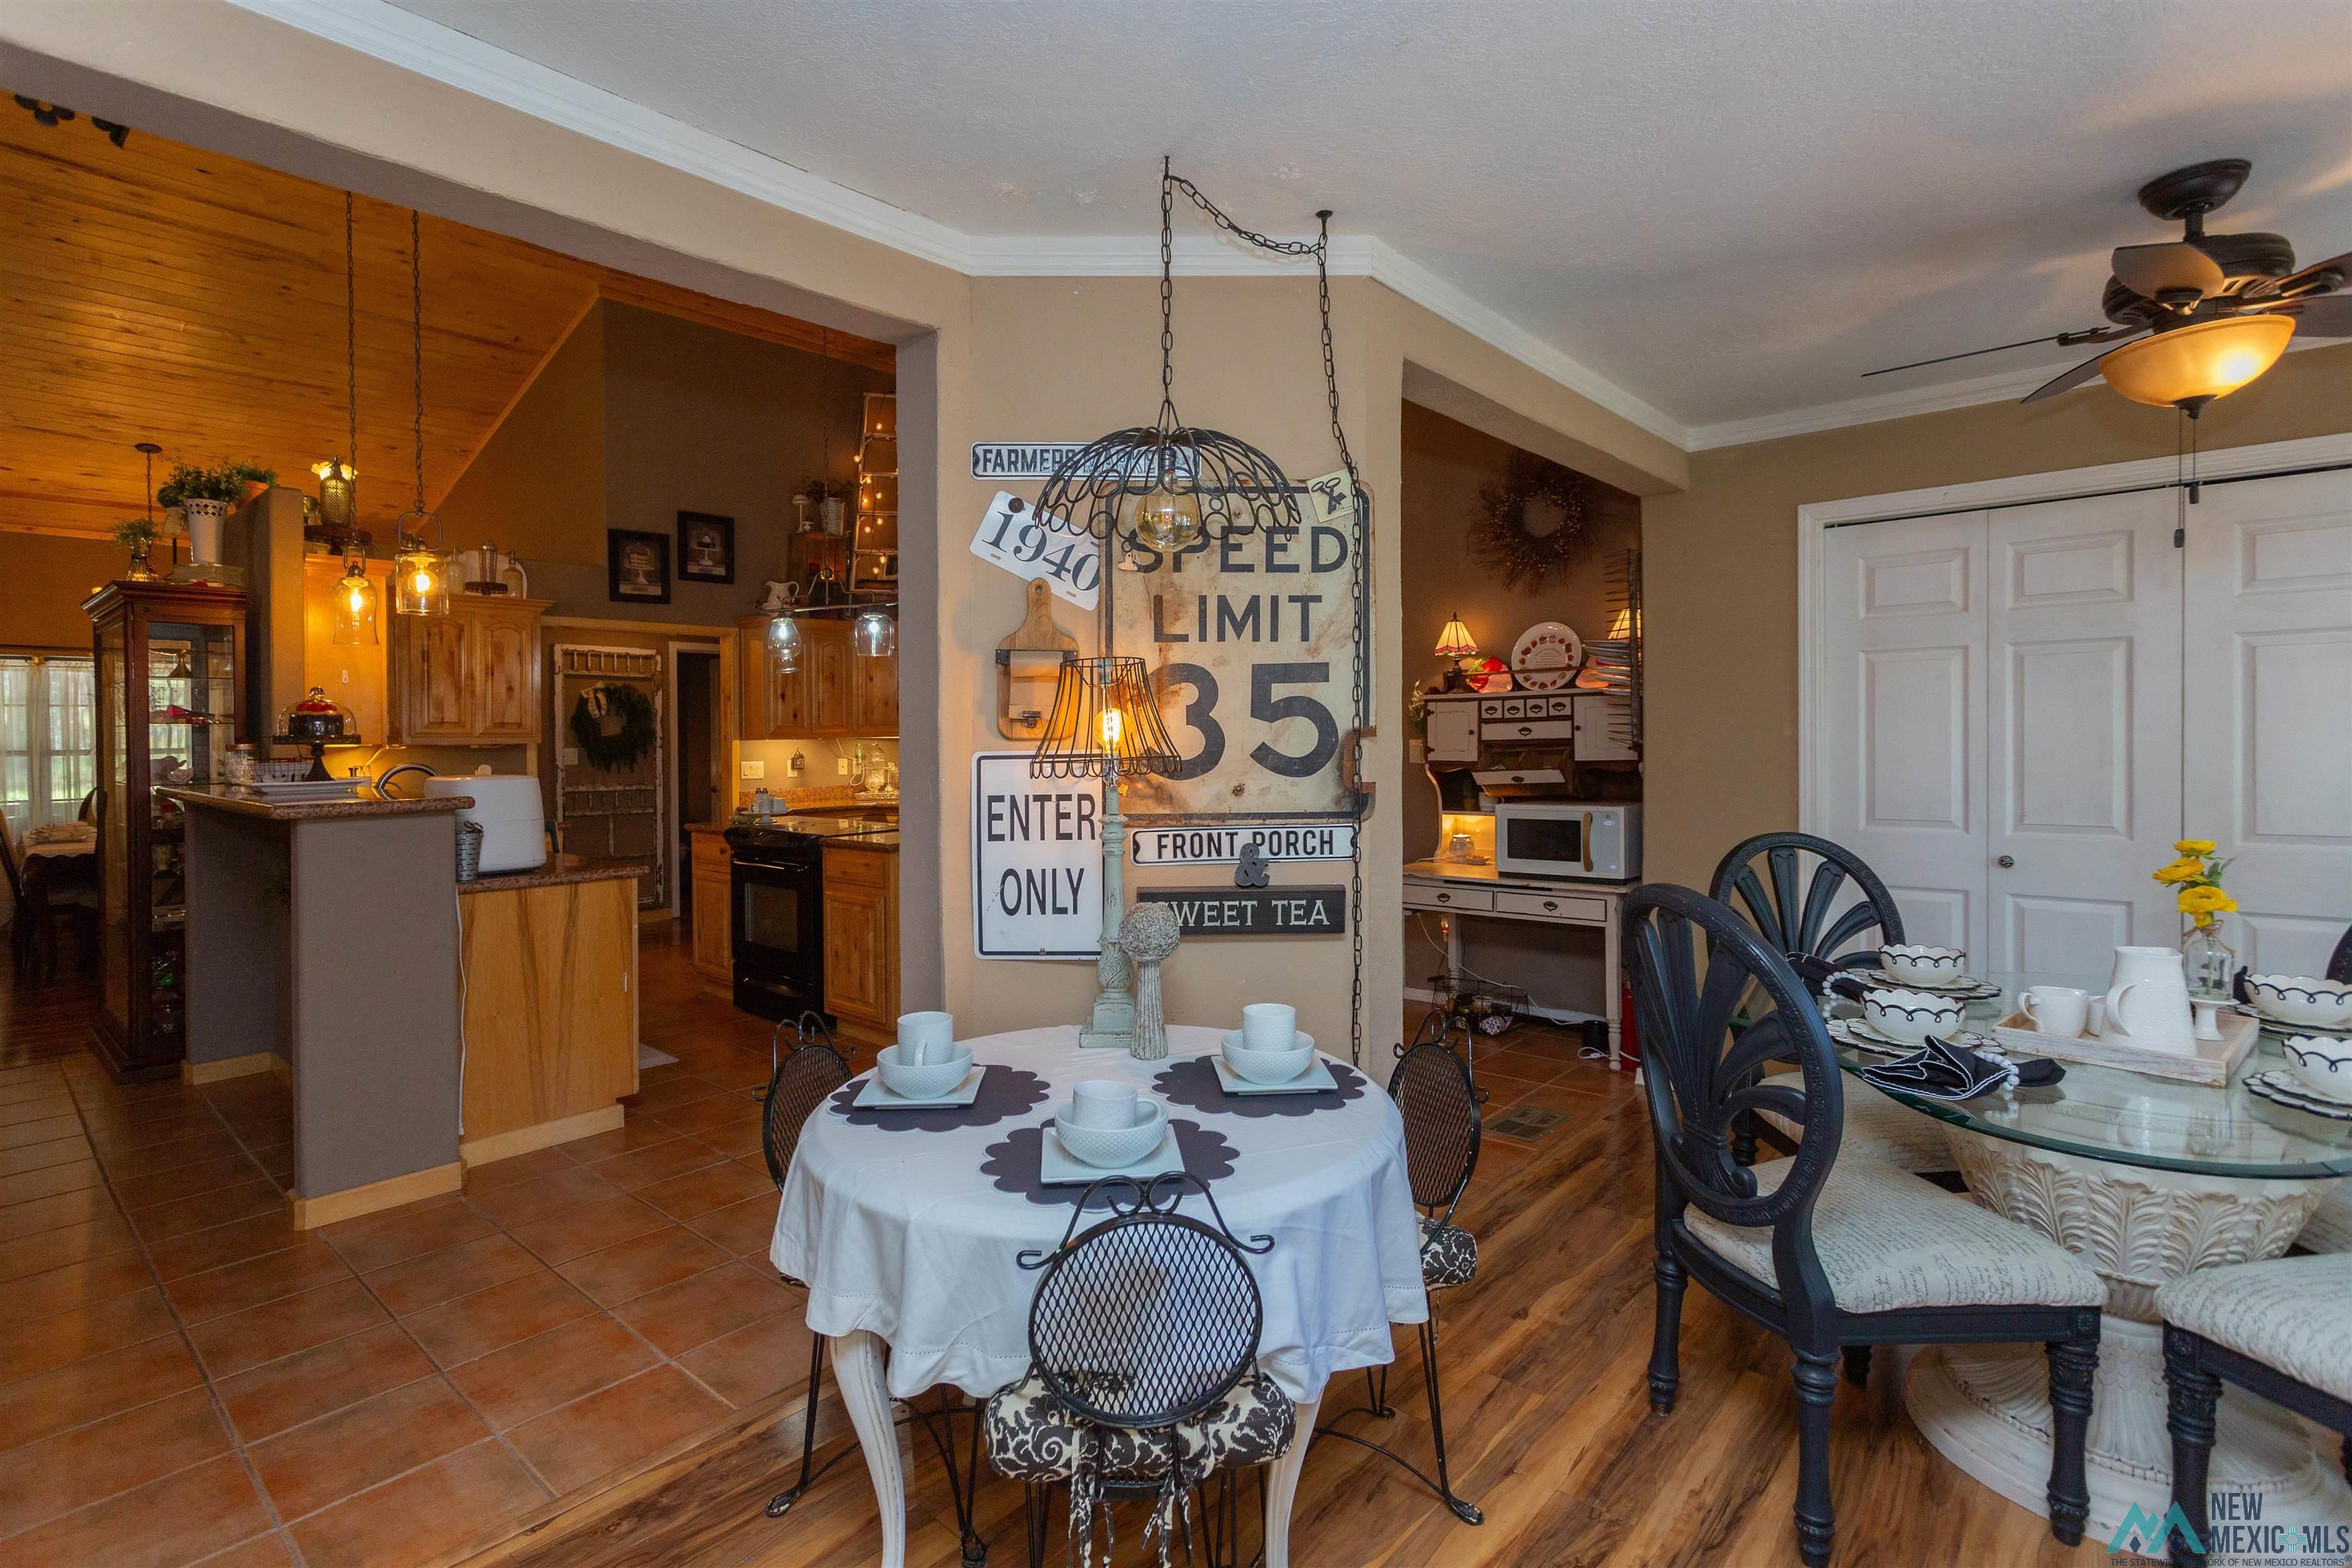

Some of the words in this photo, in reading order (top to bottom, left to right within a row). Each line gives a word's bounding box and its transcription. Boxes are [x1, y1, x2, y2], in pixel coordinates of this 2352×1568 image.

[1082, 446, 1157, 473] MARKE
[982, 511, 1100, 591] 1940
[1128, 525, 1348, 573] SPEED
[1153, 594, 1322, 642] LIMIT
[1140, 662, 1339, 781] 35
[987, 793, 1096, 841] ENTER
[1157, 831, 1239, 860] FRONT
[1252, 829, 1334, 857] PORCH
[1233, 842, 1271, 887] &
[999, 867, 1085, 916] ONLY
[1164, 900, 1258, 926] WEET
[1271, 900, 1330, 926] TEA
